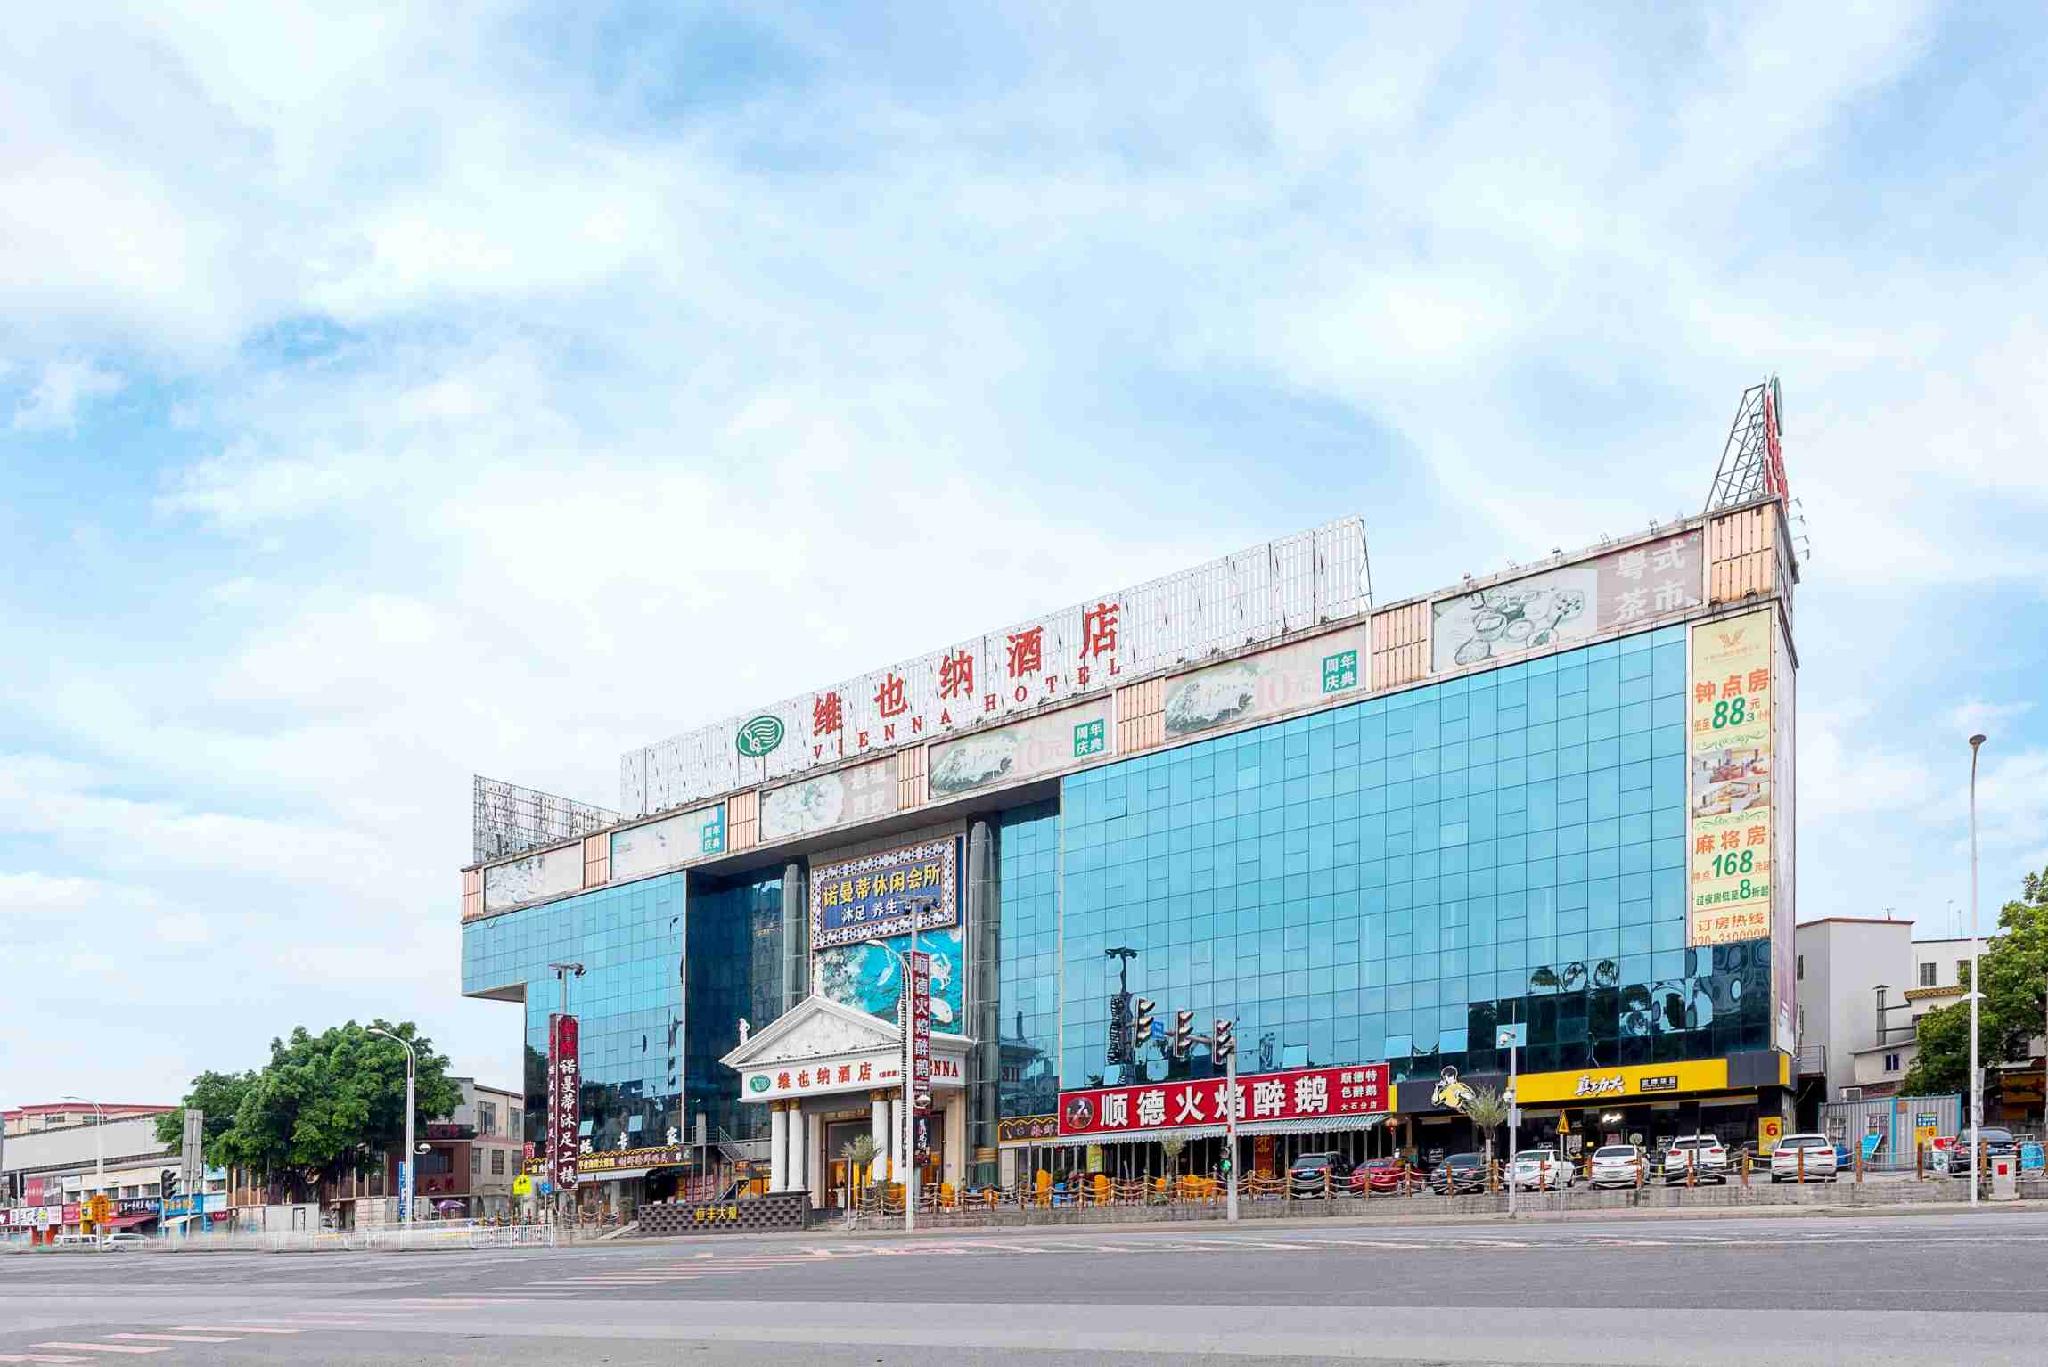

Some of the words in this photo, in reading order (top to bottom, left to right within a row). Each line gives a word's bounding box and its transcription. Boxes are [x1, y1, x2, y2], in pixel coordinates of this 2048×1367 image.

[813, 603, 1119, 736] 维也纳酒店
[1696, 668, 1769, 703] 钟点房
[813, 707, 952, 758] VIENNA
[984, 663, 1121, 712] HOTEL
[1712, 697, 1746, 729] 88
[1696, 825, 1766, 854] 麻将房
[1712, 850, 1753, 877] 168
[823, 864, 940, 906] 诺曼蒂休闲会所
[842, 905, 866, 922] 沐足
[872, 898, 898, 917] 养生
[1698, 912, 1765, 932] 订房热线
[777, 1061, 872, 1089] 维也纳酒店
[1575, 1074, 1625, 1096] 真功夫
[1100, 1076, 1328, 1127] 顺德火焰醉鹅
